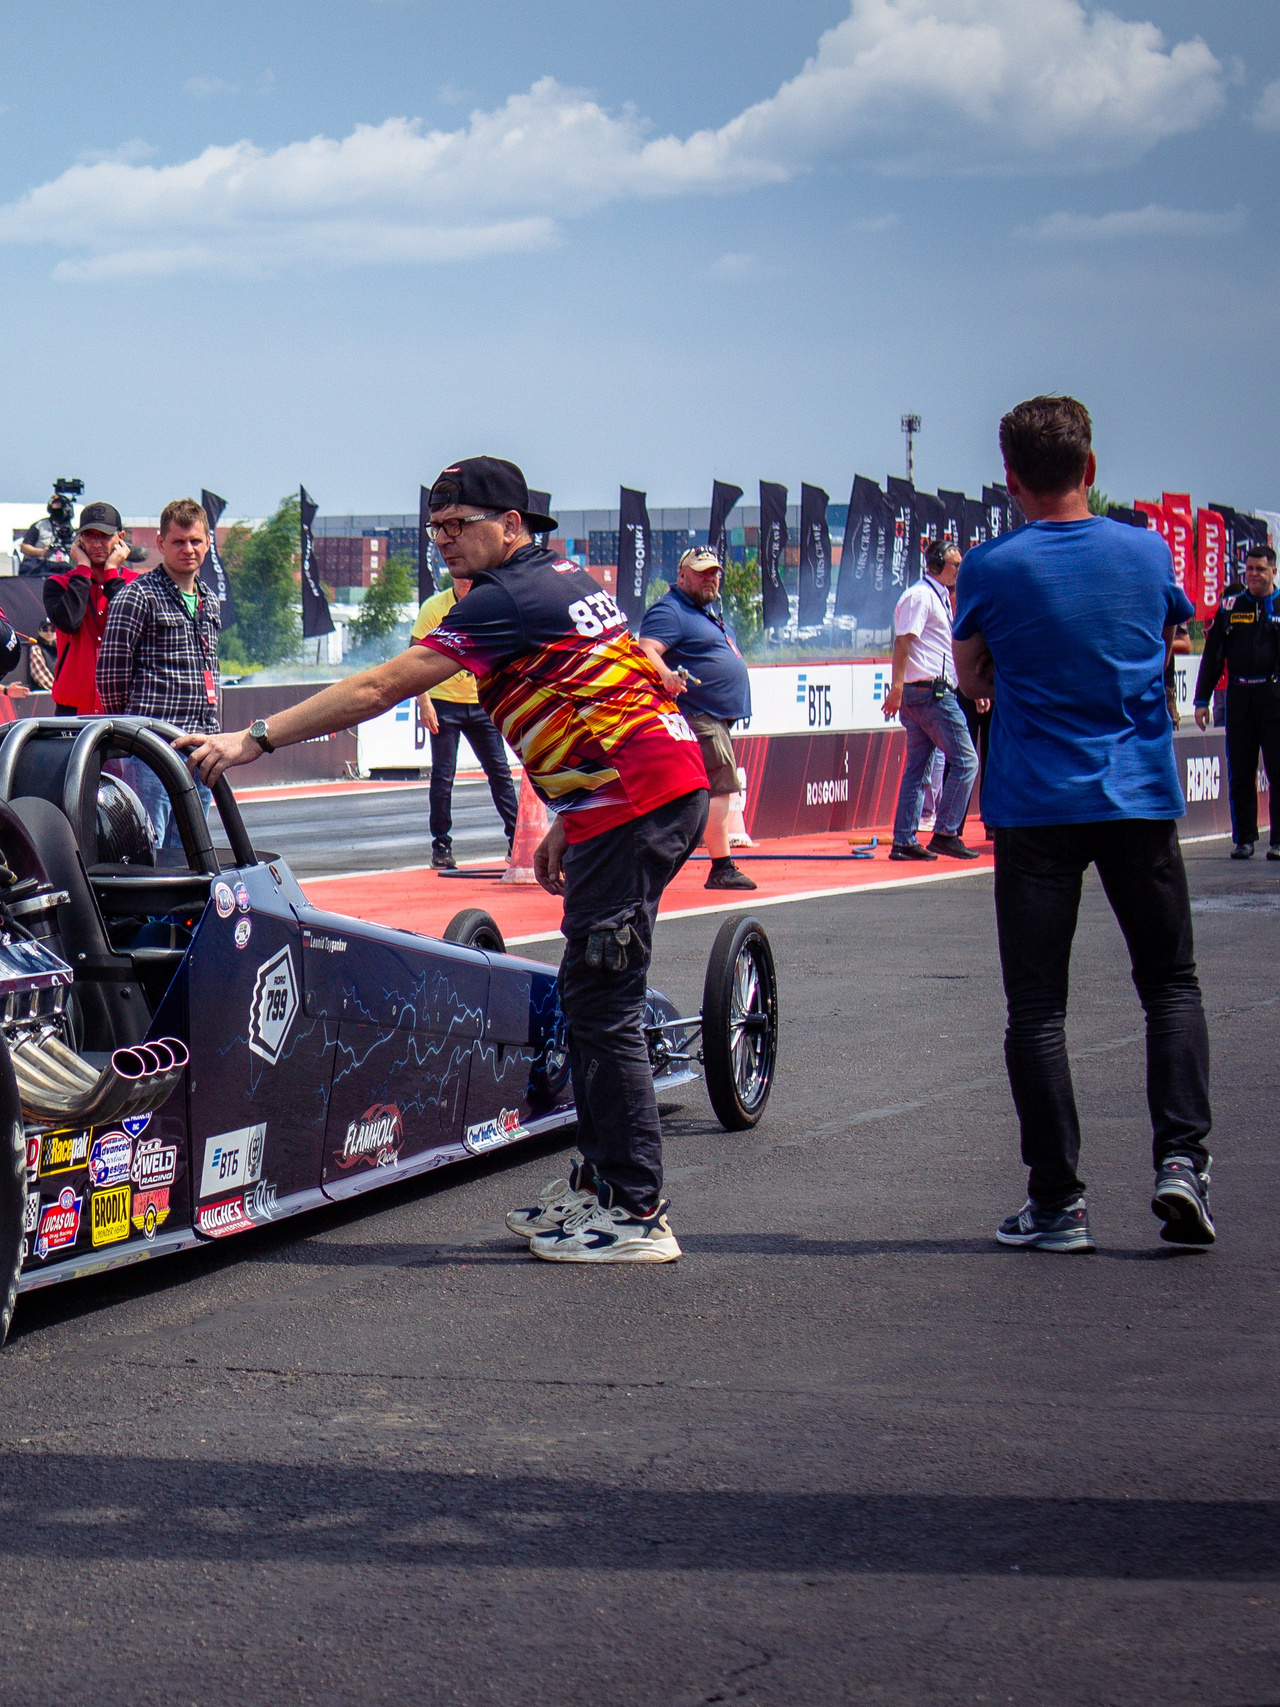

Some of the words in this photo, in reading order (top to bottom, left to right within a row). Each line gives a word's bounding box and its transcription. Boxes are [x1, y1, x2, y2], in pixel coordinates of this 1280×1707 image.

[1203, 522, 1220, 608] auto.ru
[808, 685, 832, 728] ВТБ
[806, 778, 849, 806] ROSGONKI
[1186, 755, 1220, 802] RDRC
[266, 988, 288, 1022] 799
[51, 1131, 90, 1167] Racepak
[142, 1150, 175, 1176] WELD
[219, 1149, 239, 1180] ВТБ
[376, 1148, 400, 1169] Racing
[141, 1172, 174, 1185] RACING
[41, 1214, 64, 1235] LUCAS
[63, 1211, 76, 1230] OIL
[95, 1190, 128, 1228] BRODIX
[200, 1200, 243, 1231] HUGHES
